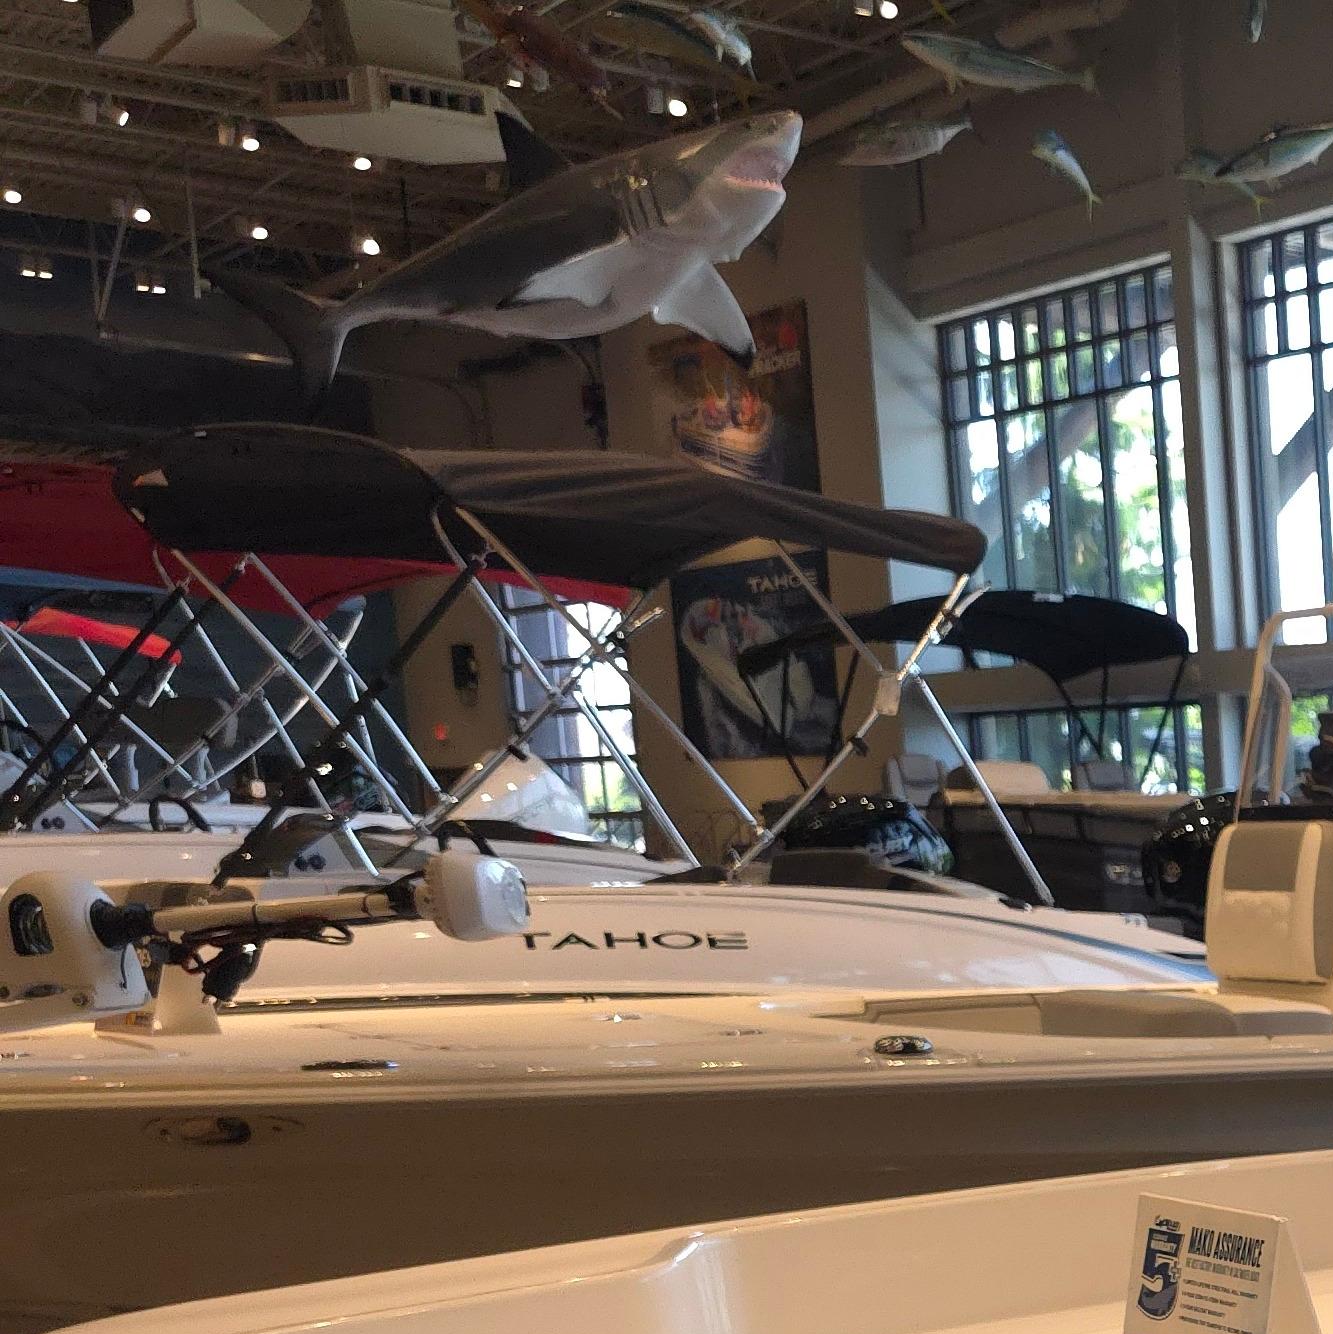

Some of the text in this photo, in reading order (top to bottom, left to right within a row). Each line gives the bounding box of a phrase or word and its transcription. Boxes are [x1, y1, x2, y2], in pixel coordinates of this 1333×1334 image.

[519, 930, 749, 950] TAHOE
[1188, 1226, 1215, 1258] MAKO
[1213, 1231, 1265, 1268] ASSURANCE
